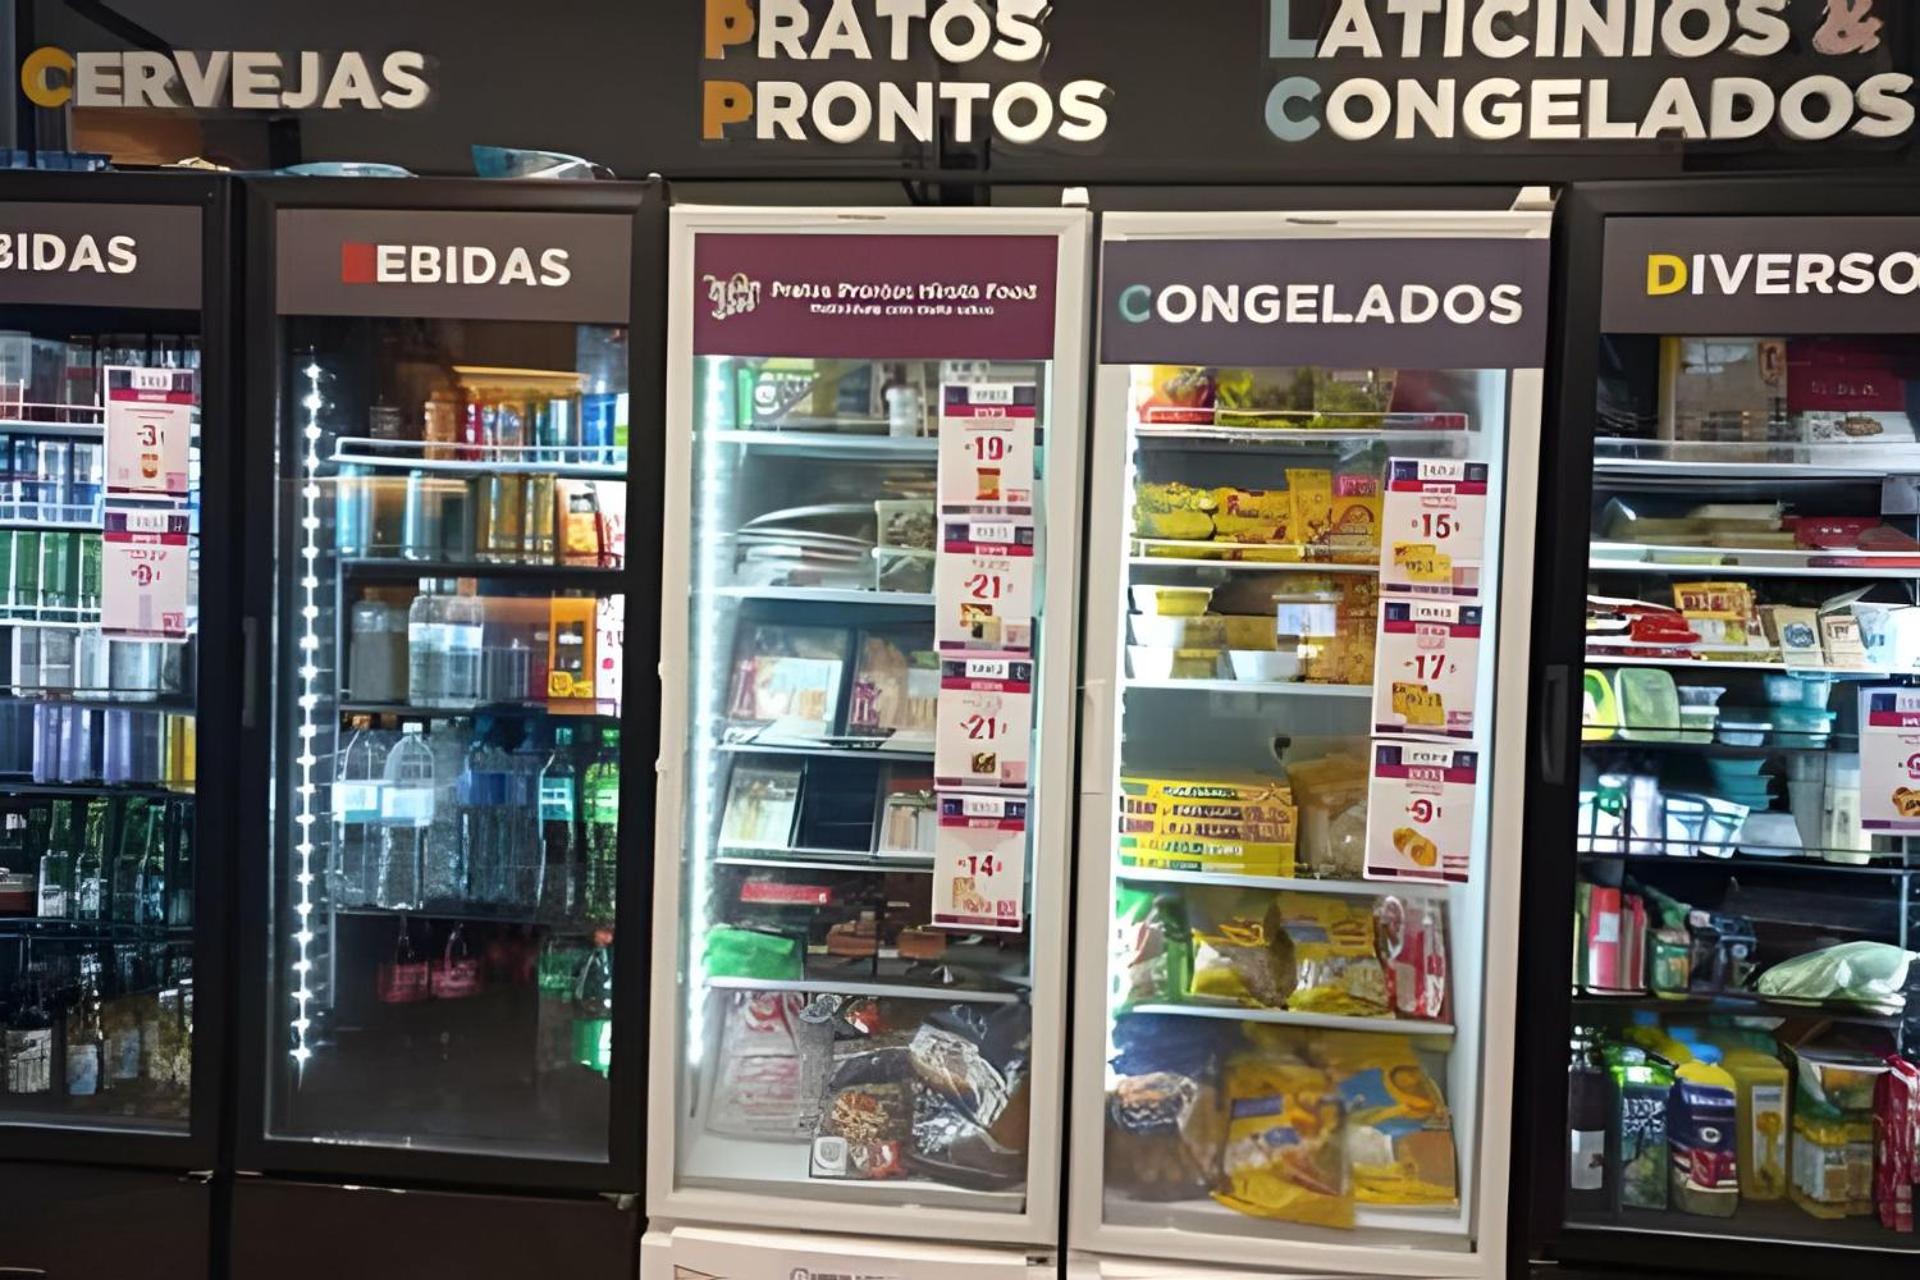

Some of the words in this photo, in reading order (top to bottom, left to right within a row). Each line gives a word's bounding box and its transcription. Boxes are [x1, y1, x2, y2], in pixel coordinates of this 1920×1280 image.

[703, 0, 1048, 63] PRATOS
[21, 46, 430, 110] CERVEJAS
[703, 80, 1109, 144] PRONTOS
[1264, 72, 1915, 142] CONGELADOS
[342, 243, 571, 287] EBIDAS
[1119, 283, 1523, 326] CONGELADOS
[1422, 513, 1451, 539] 15
[967, 854, 994, 878] 14
